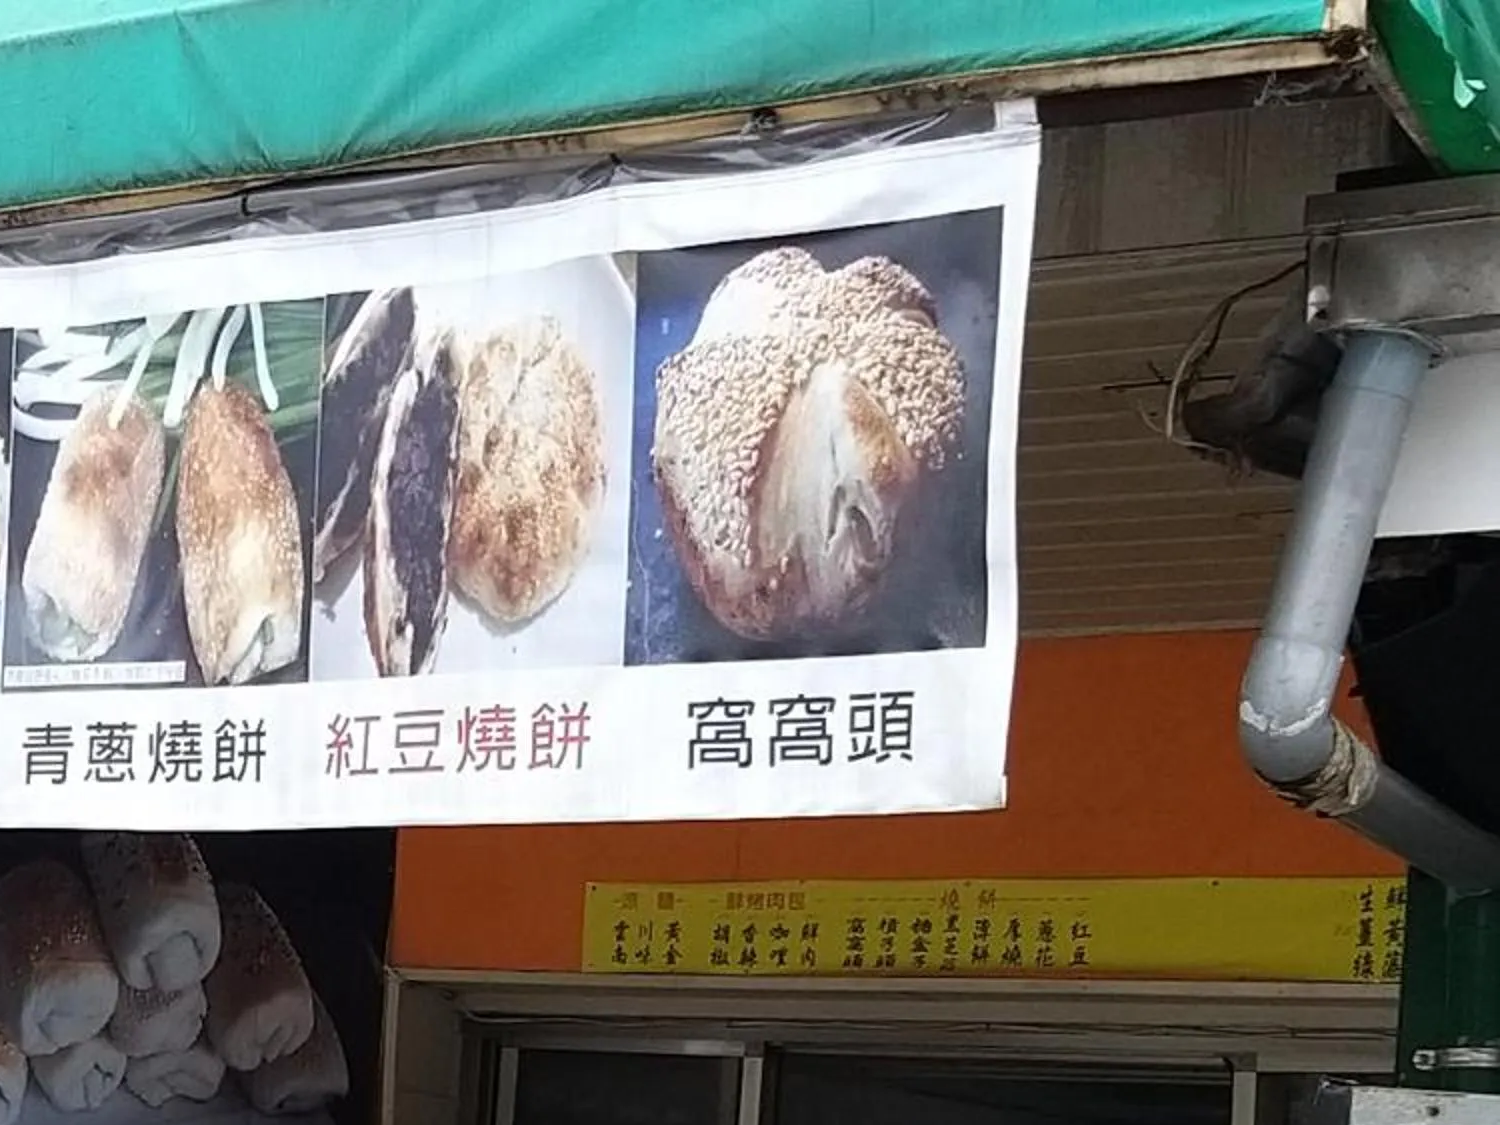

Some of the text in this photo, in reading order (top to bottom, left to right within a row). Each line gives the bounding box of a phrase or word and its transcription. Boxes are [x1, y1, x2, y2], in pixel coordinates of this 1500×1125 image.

[21, 719, 269, 786] 青蔥燒餅
[325, 700, 593, 777] 紅豆燒餅
[685, 690, 916, 769] 窩窩頭
